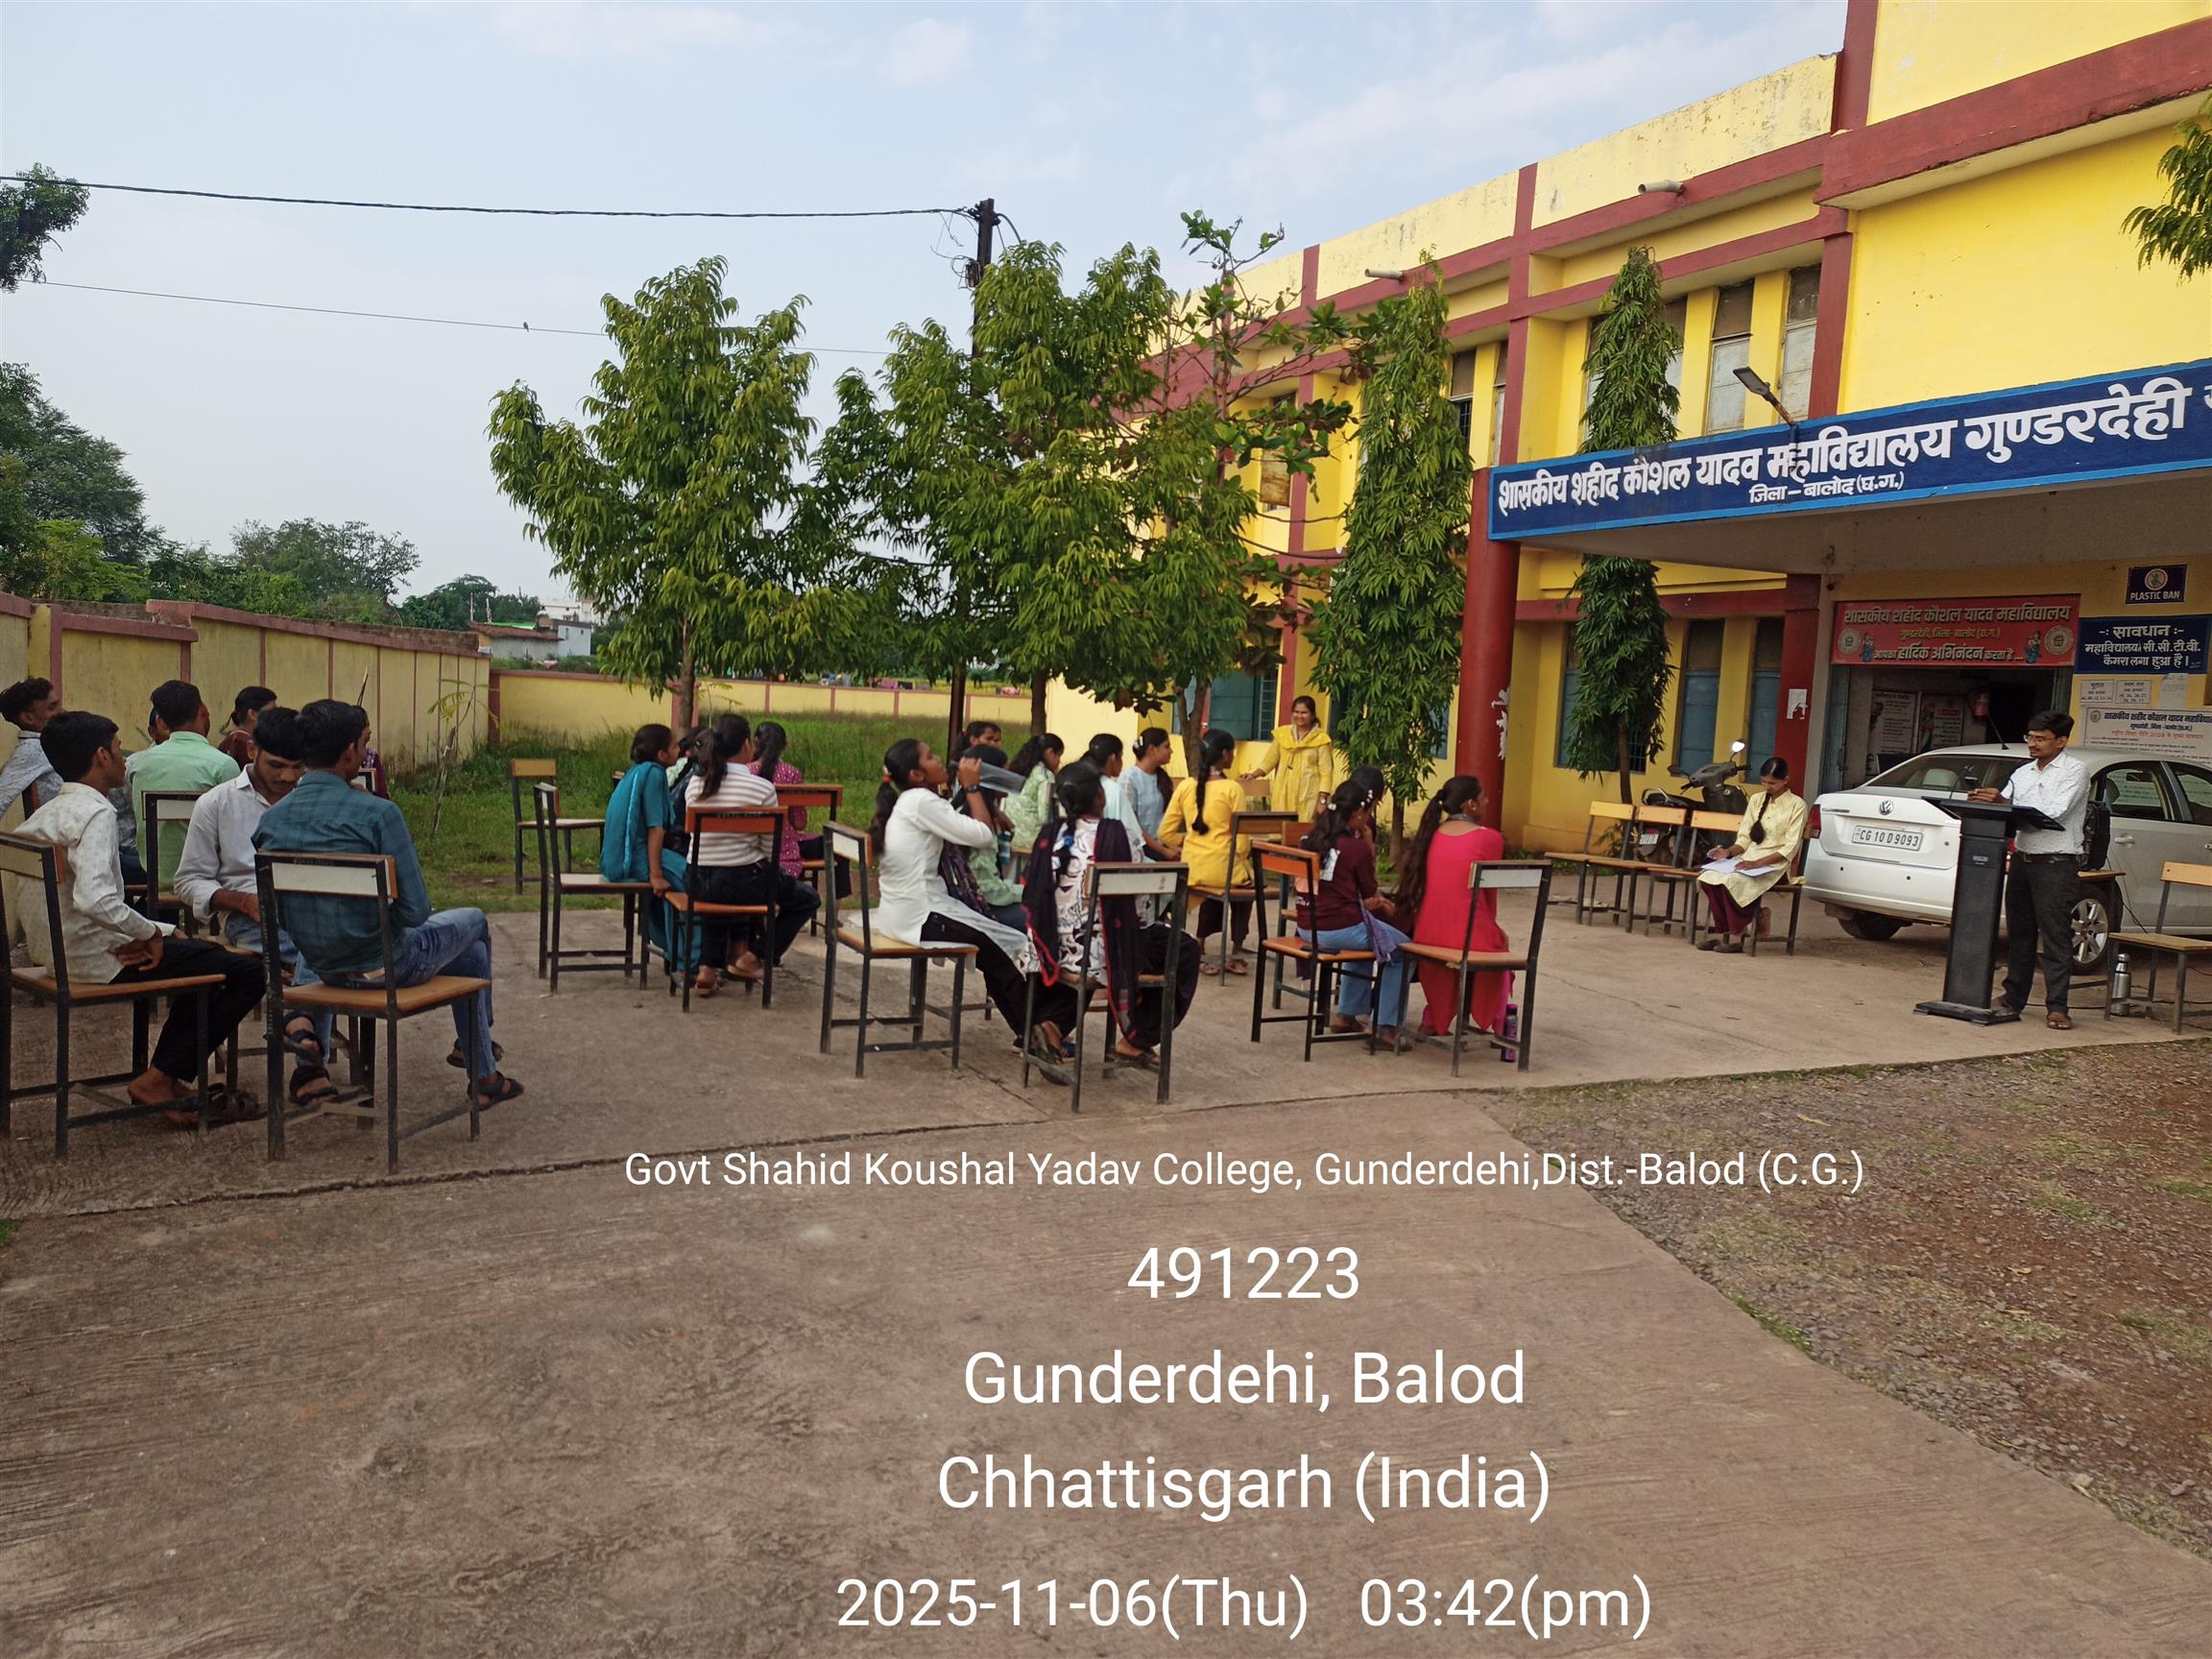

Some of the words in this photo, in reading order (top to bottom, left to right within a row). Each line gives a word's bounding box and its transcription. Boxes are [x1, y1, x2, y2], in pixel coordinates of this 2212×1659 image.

[1498, 469, 1570, 517] शासकीय
[1571, 462, 1622, 507] शहीद
[1695, 447, 1763, 487] यादव
[1767, 420, 1958, 484] महाविद्यालय
[1964, 376, 2193, 464] गुण्डरदेही
[2129, 590, 2161, 601] PLASTIC
[2162, 590, 2180, 600] BAN
[1843, 606, 1890, 624] शासकीय
[1892, 605, 1923, 623] शहीद
[1924, 605, 1962, 622] कौशल
[1964, 608, 1995, 621] यादव
[2112, 624, 2171, 639] सावधान
[2129, 657, 2150, 666] लगा
[2152, 656, 2172, 669] हुआ
[1860, 830, 1872, 841] CG
[1874, 831, 1886, 843] 10
